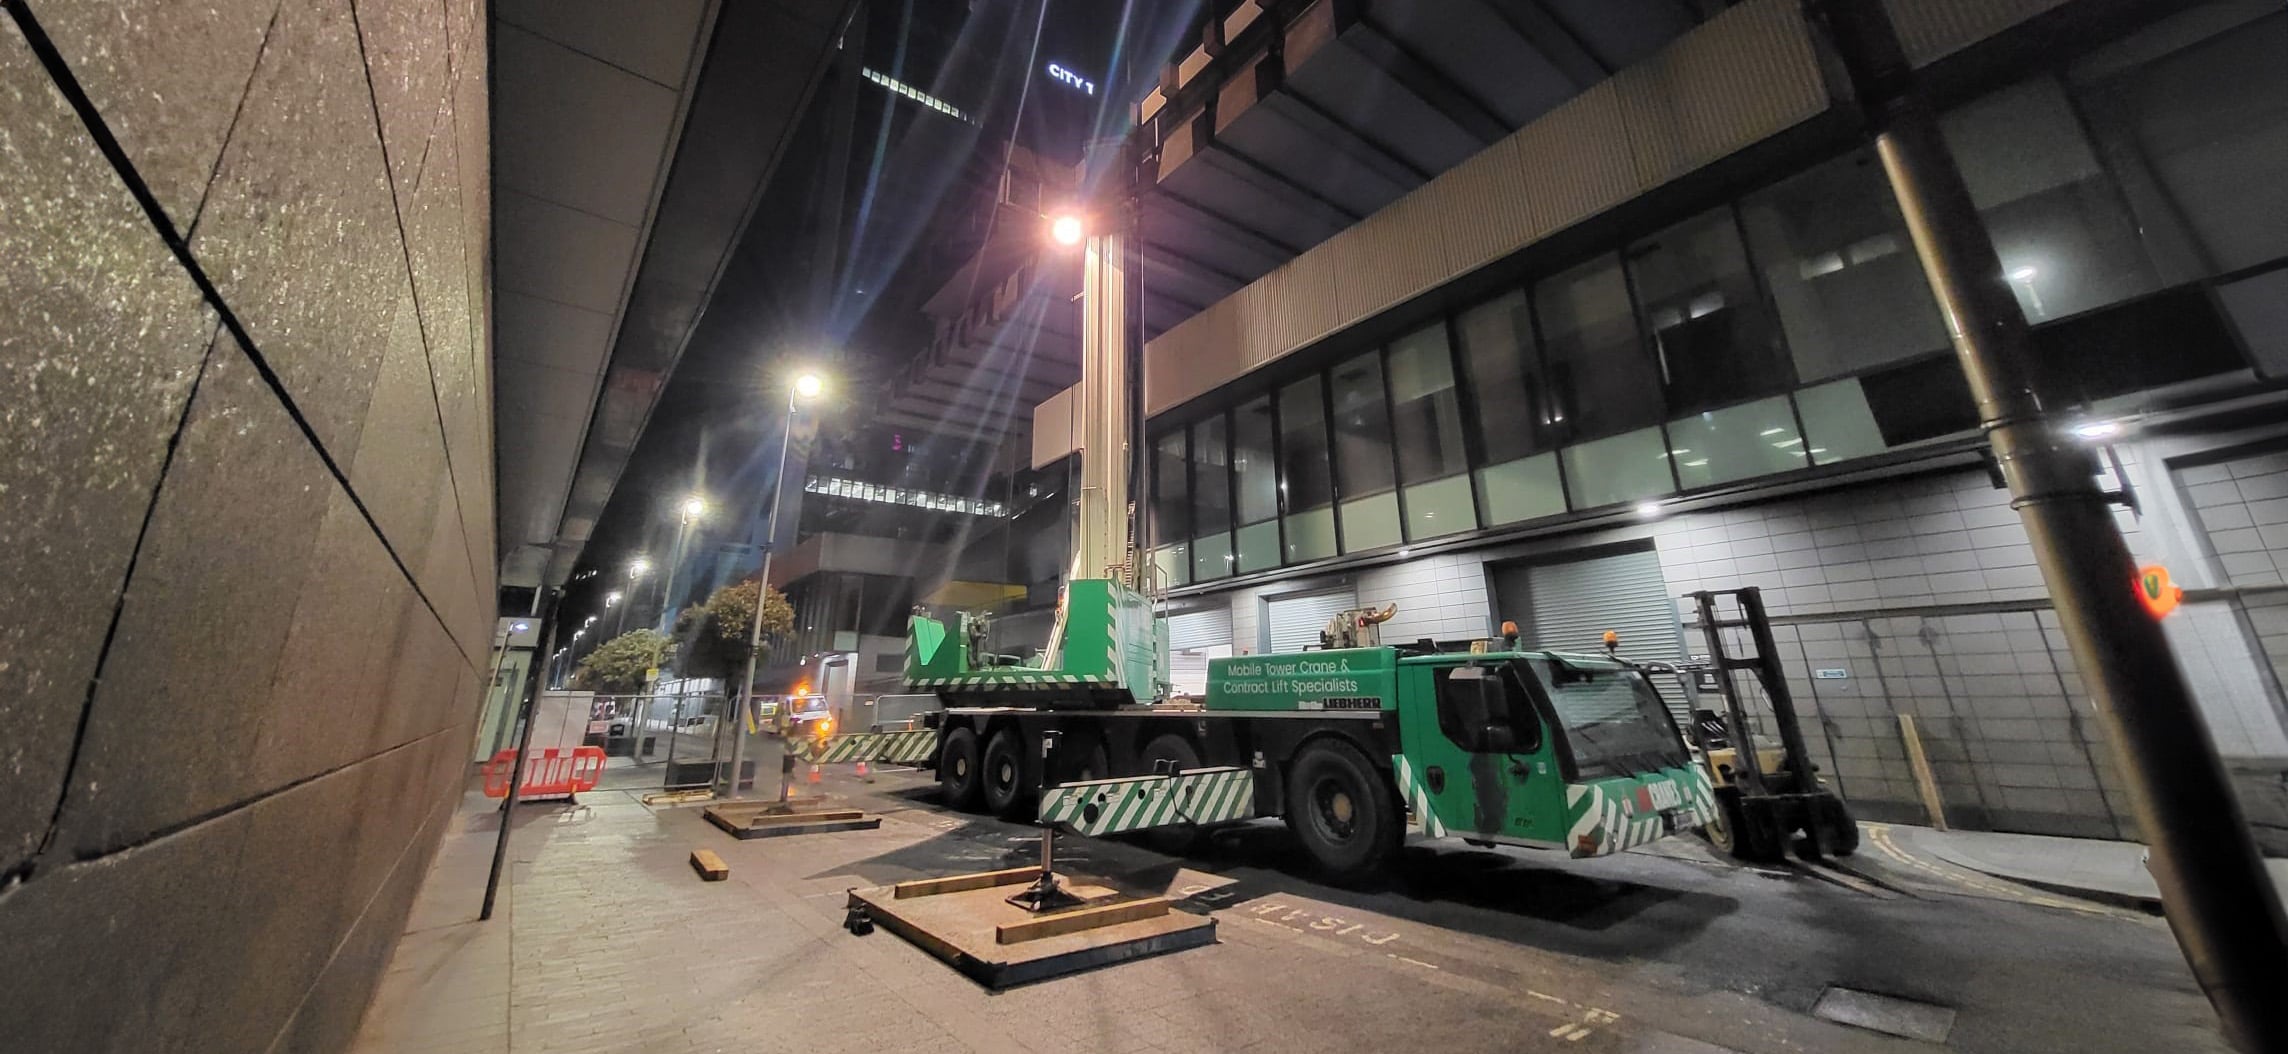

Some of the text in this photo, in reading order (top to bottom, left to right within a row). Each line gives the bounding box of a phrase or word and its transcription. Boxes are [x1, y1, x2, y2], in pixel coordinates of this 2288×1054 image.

[1048, 63, 1083, 89] CITY
[1227, 658, 1350, 676] Mobile Tower Crane &
[1223, 678, 1358, 696] Contract Lift Specialists
[1323, 697, 1381, 709] LIEBHERR
